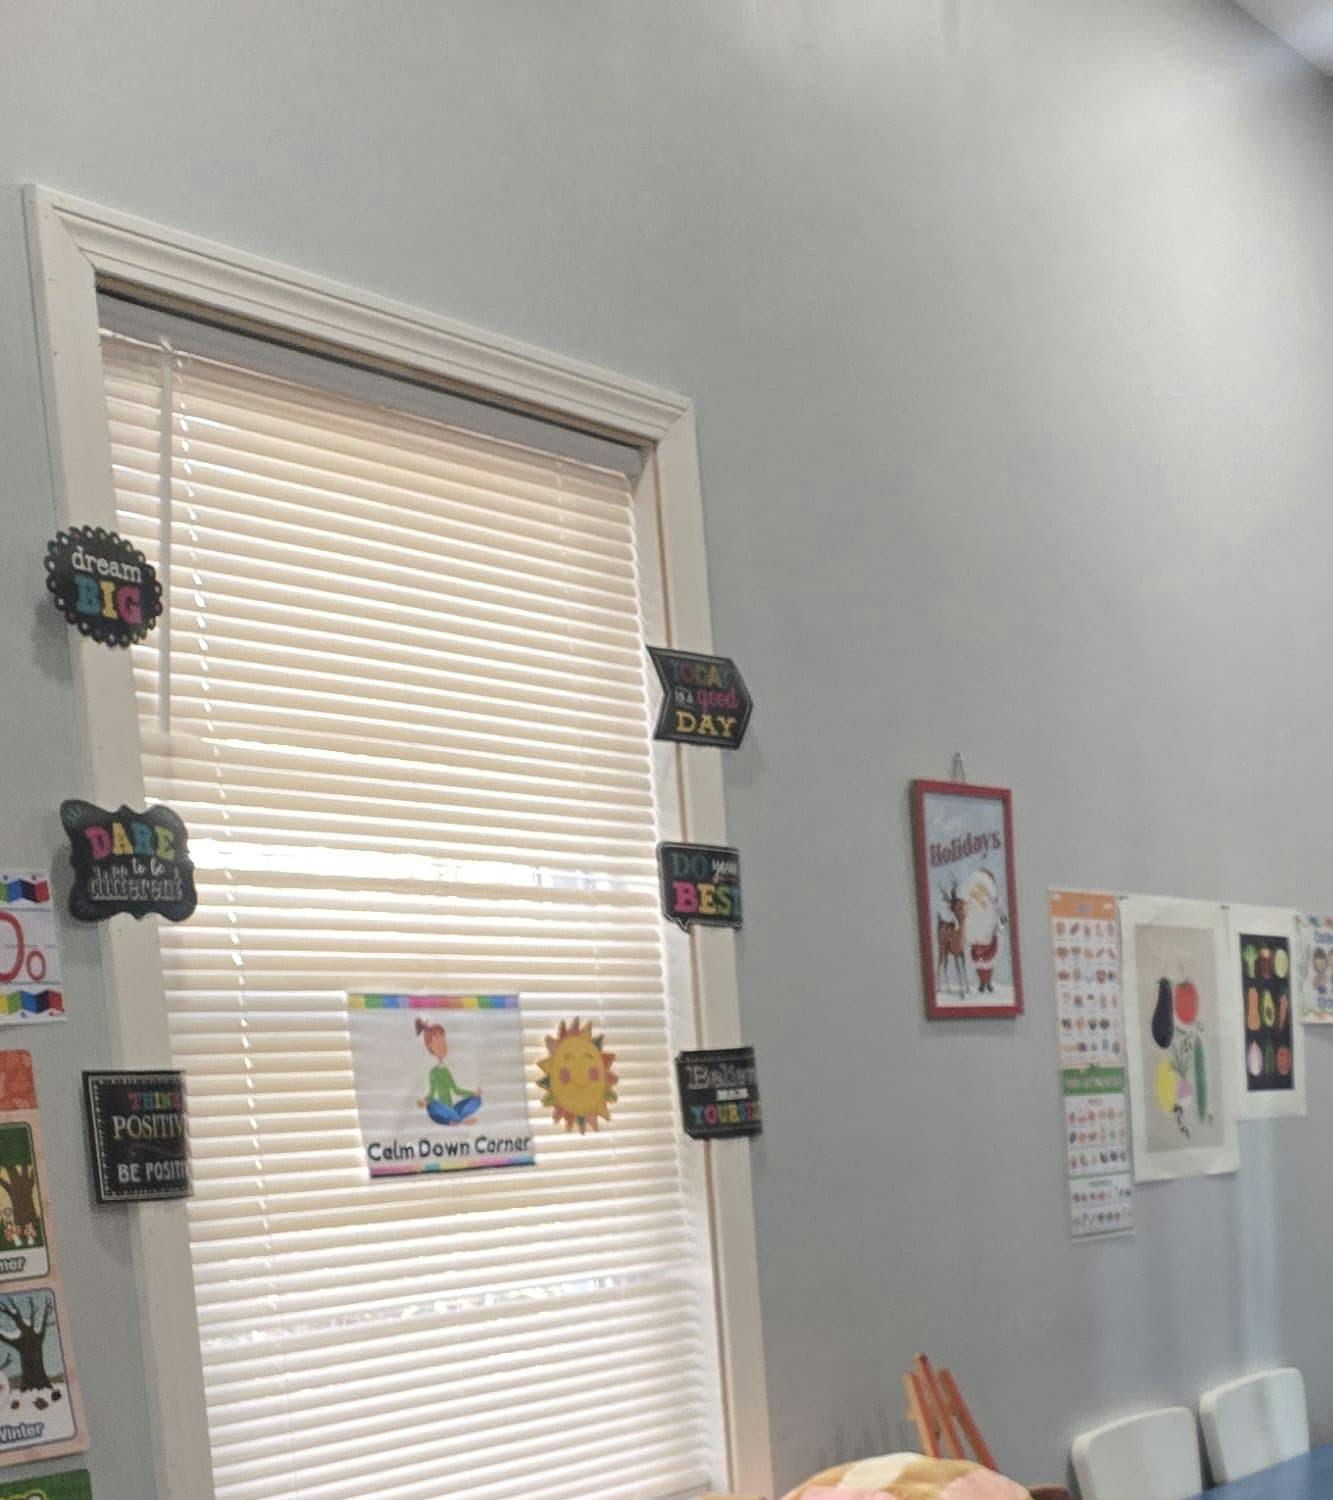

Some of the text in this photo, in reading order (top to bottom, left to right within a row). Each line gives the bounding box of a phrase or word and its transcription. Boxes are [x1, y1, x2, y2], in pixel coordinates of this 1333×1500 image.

[71, 546, 142, 583] dream
[74, 575, 143, 624] BIG
[675, 710, 737, 738] DAY
[84, 820, 176, 862] DARE
[929, 832, 1001, 868] Holidays
[671, 852, 708, 878] DO
[112, 1113, 187, 1139] POSITIV
[367, 1136, 531, 1162] Calm Down Corner
[117, 1160, 187, 1183] BE POSITI
